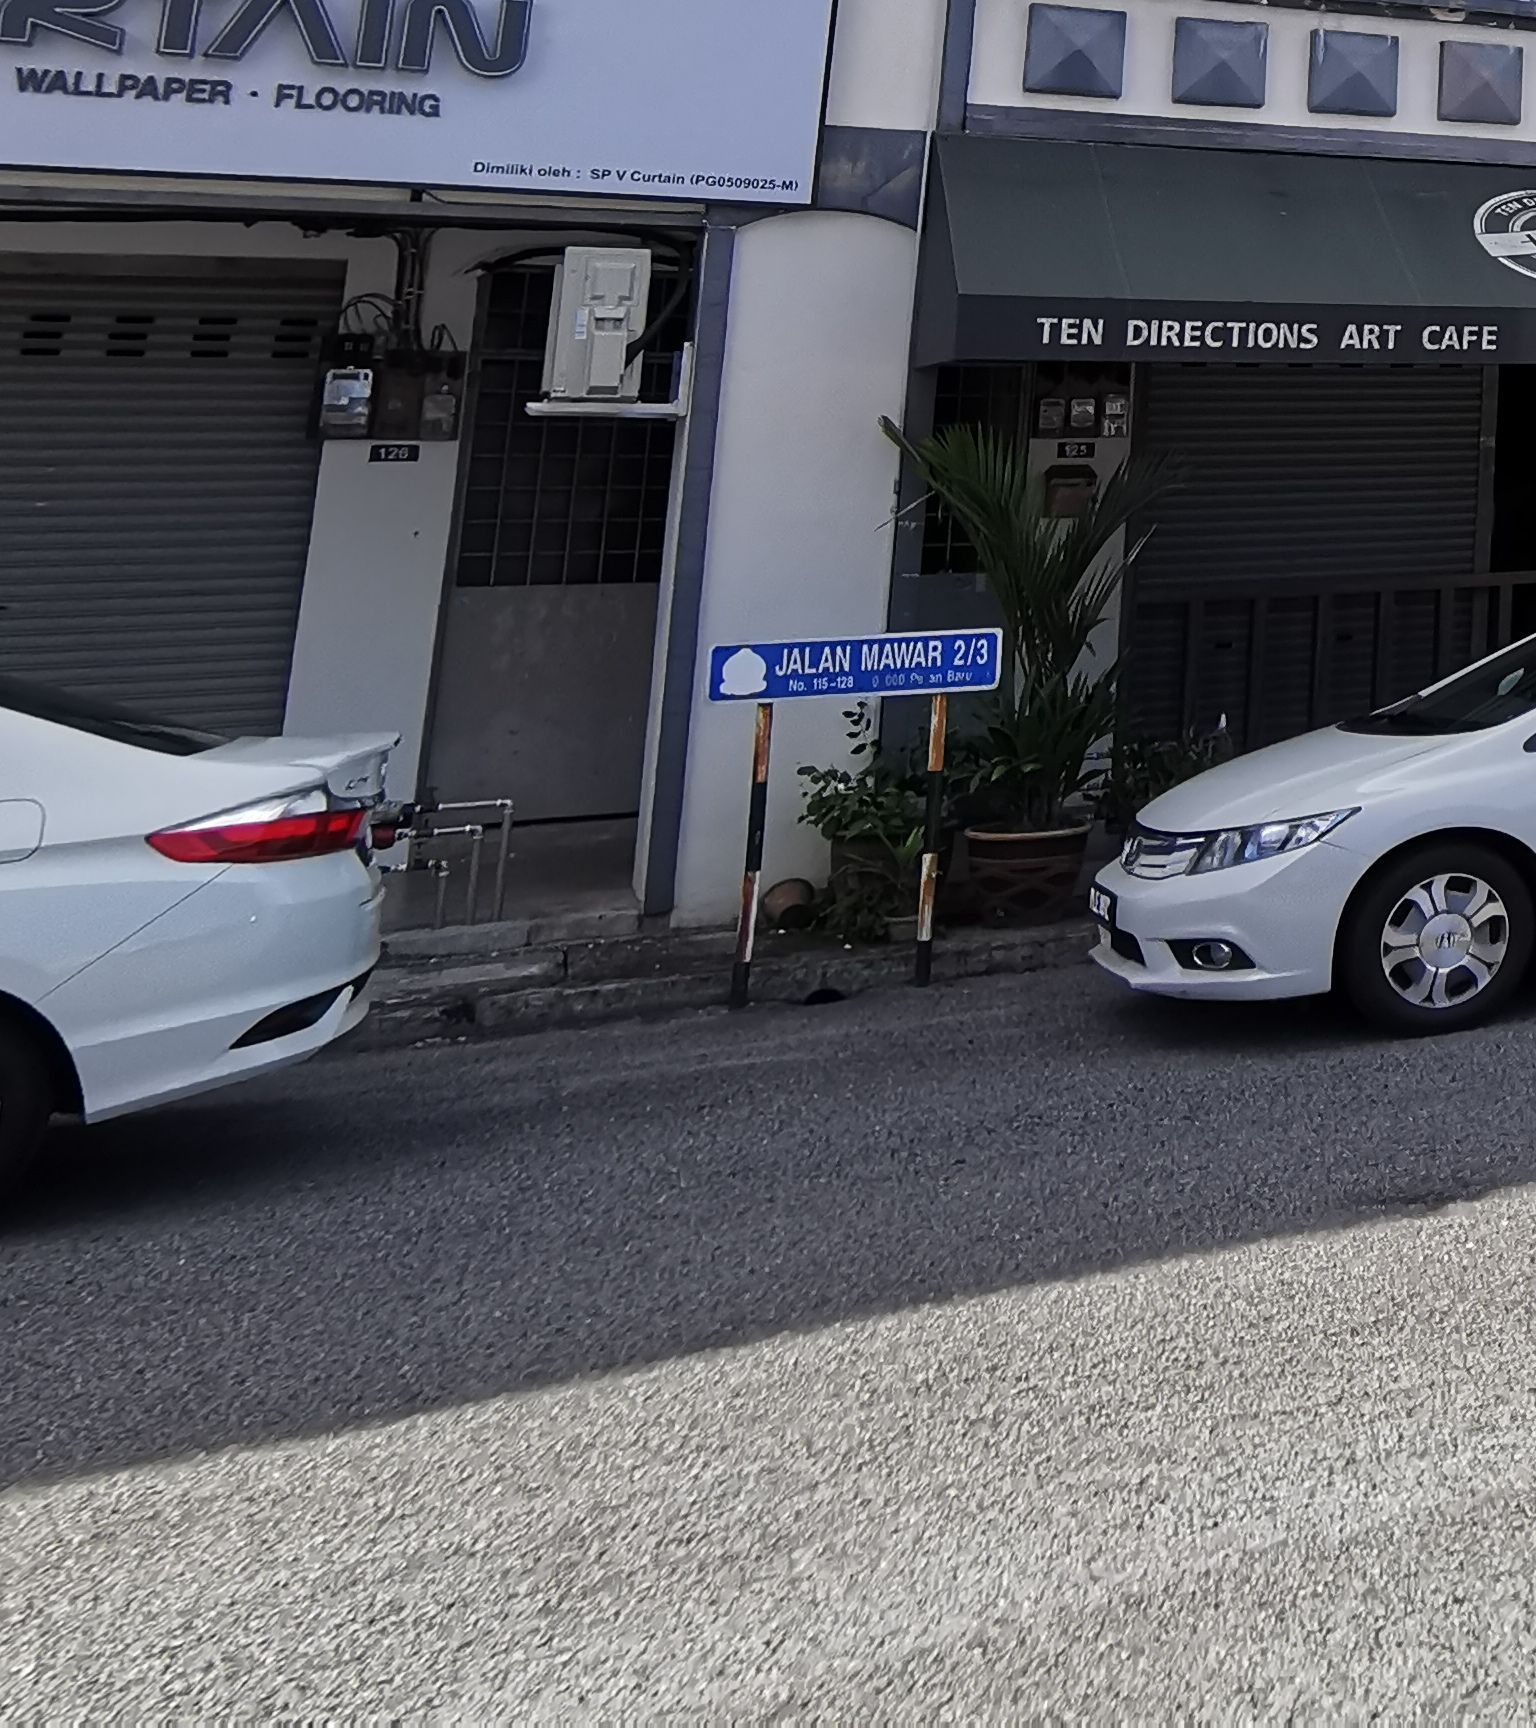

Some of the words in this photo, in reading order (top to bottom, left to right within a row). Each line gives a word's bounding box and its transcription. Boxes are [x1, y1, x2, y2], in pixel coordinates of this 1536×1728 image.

[14, 66, 233, 106] WALLPAPER
[273, 83, 442, 119] FLOORING
[472, 161, 533, 177] Dimiliki
[537, 165, 571, 178] oleh
[590, 168, 612, 181] SP
[614, 169, 630, 182] V
[630, 170, 686, 186] Curtain
[689, 174, 800, 193] (PG0509025-M)
[1495, 201, 1520, 217] TEN
[1036, 317, 1104, 346] TEN
[1125, 319, 1319, 350] DIRECTIONS
[1339, 323, 1402, 351] ART
[1420, 324, 1499, 351] CAFE
[775, 645, 851, 677] JALAN
[860, 639, 943, 672] MAWAR
[953, 637, 989, 668] 2/3
[788, 679, 808, 692] No.
